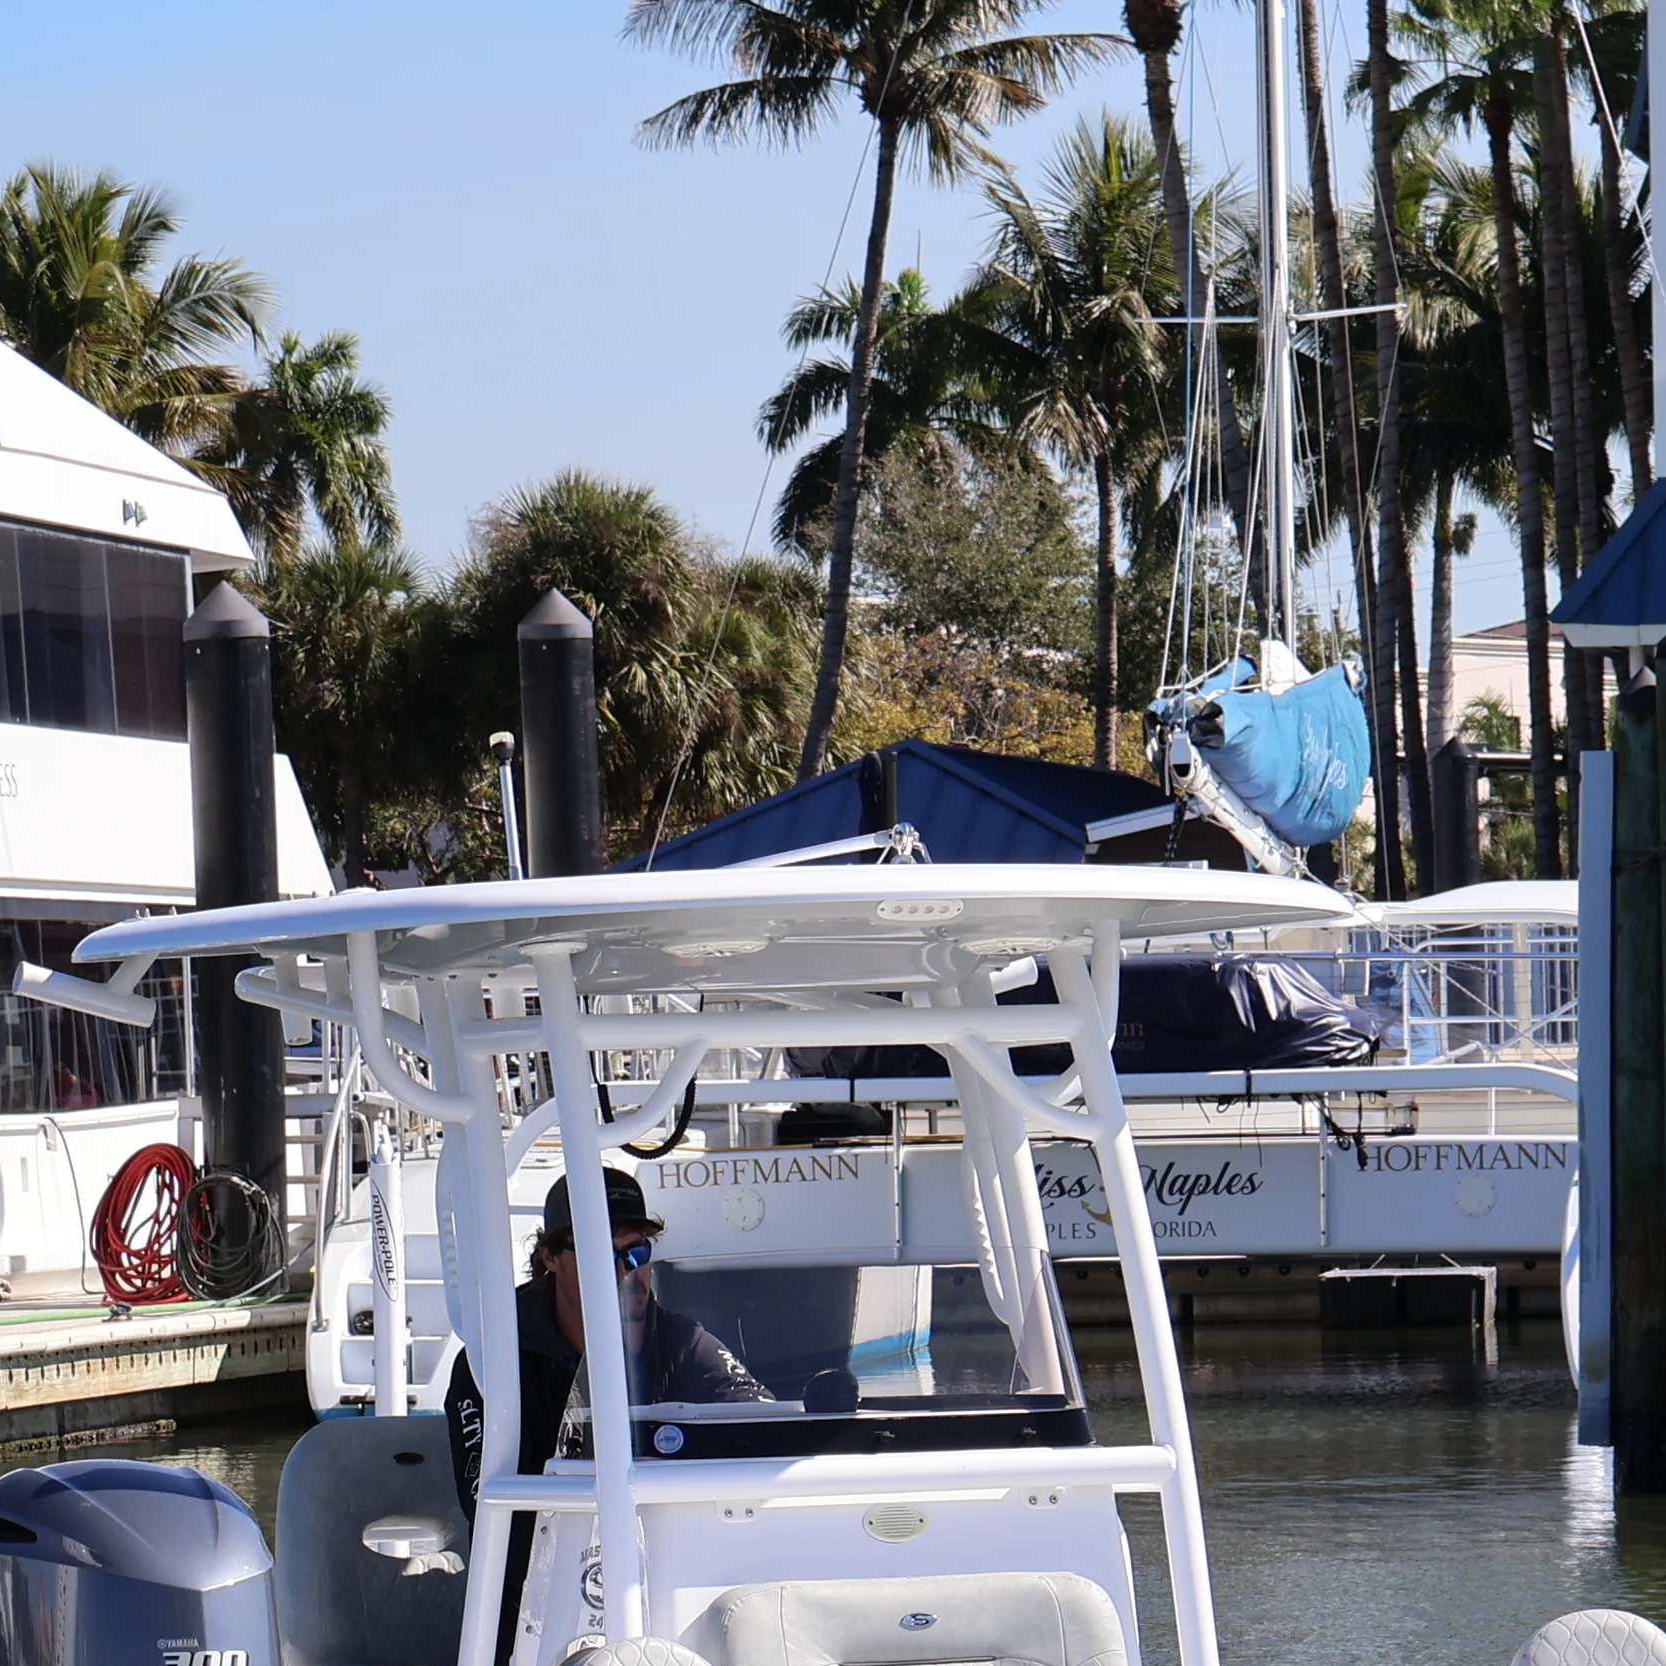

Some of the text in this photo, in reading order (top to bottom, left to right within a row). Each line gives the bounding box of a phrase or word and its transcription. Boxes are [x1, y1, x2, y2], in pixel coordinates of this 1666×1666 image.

[656, 1153, 862, 1190] HOFFMANN
[1356, 1141, 1569, 1172] HOFFMANN
[1033, 1160, 1264, 1216] iss Naples
[1046, 1220, 1217, 1240] PLES ORIDA
[166, 1638, 200, 1649] YAMAHA
